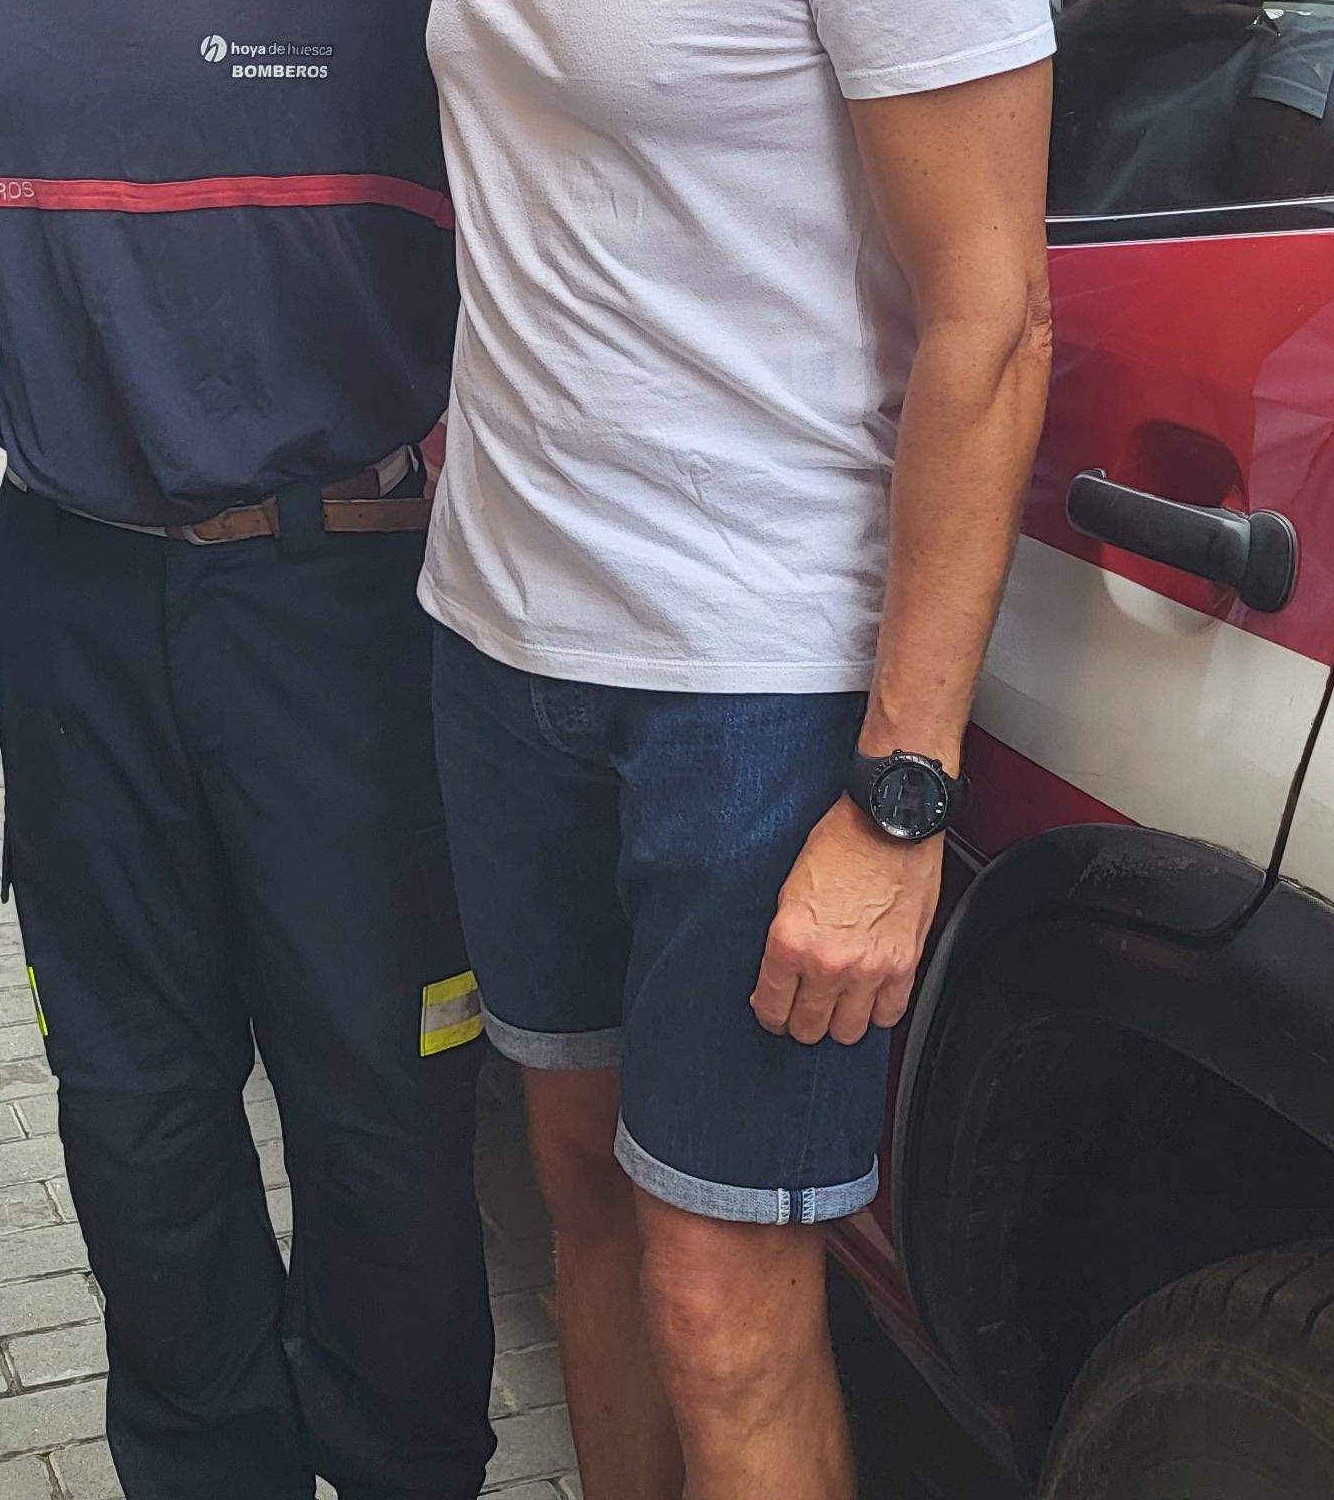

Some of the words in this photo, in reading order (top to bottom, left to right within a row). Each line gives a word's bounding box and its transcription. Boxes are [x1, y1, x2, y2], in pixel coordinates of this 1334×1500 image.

[230, 41, 266, 58] hoya
[268, 42, 285, 55] de
[287, 42, 333, 56] huesca
[231, 64, 328, 79] BOMBEROS
